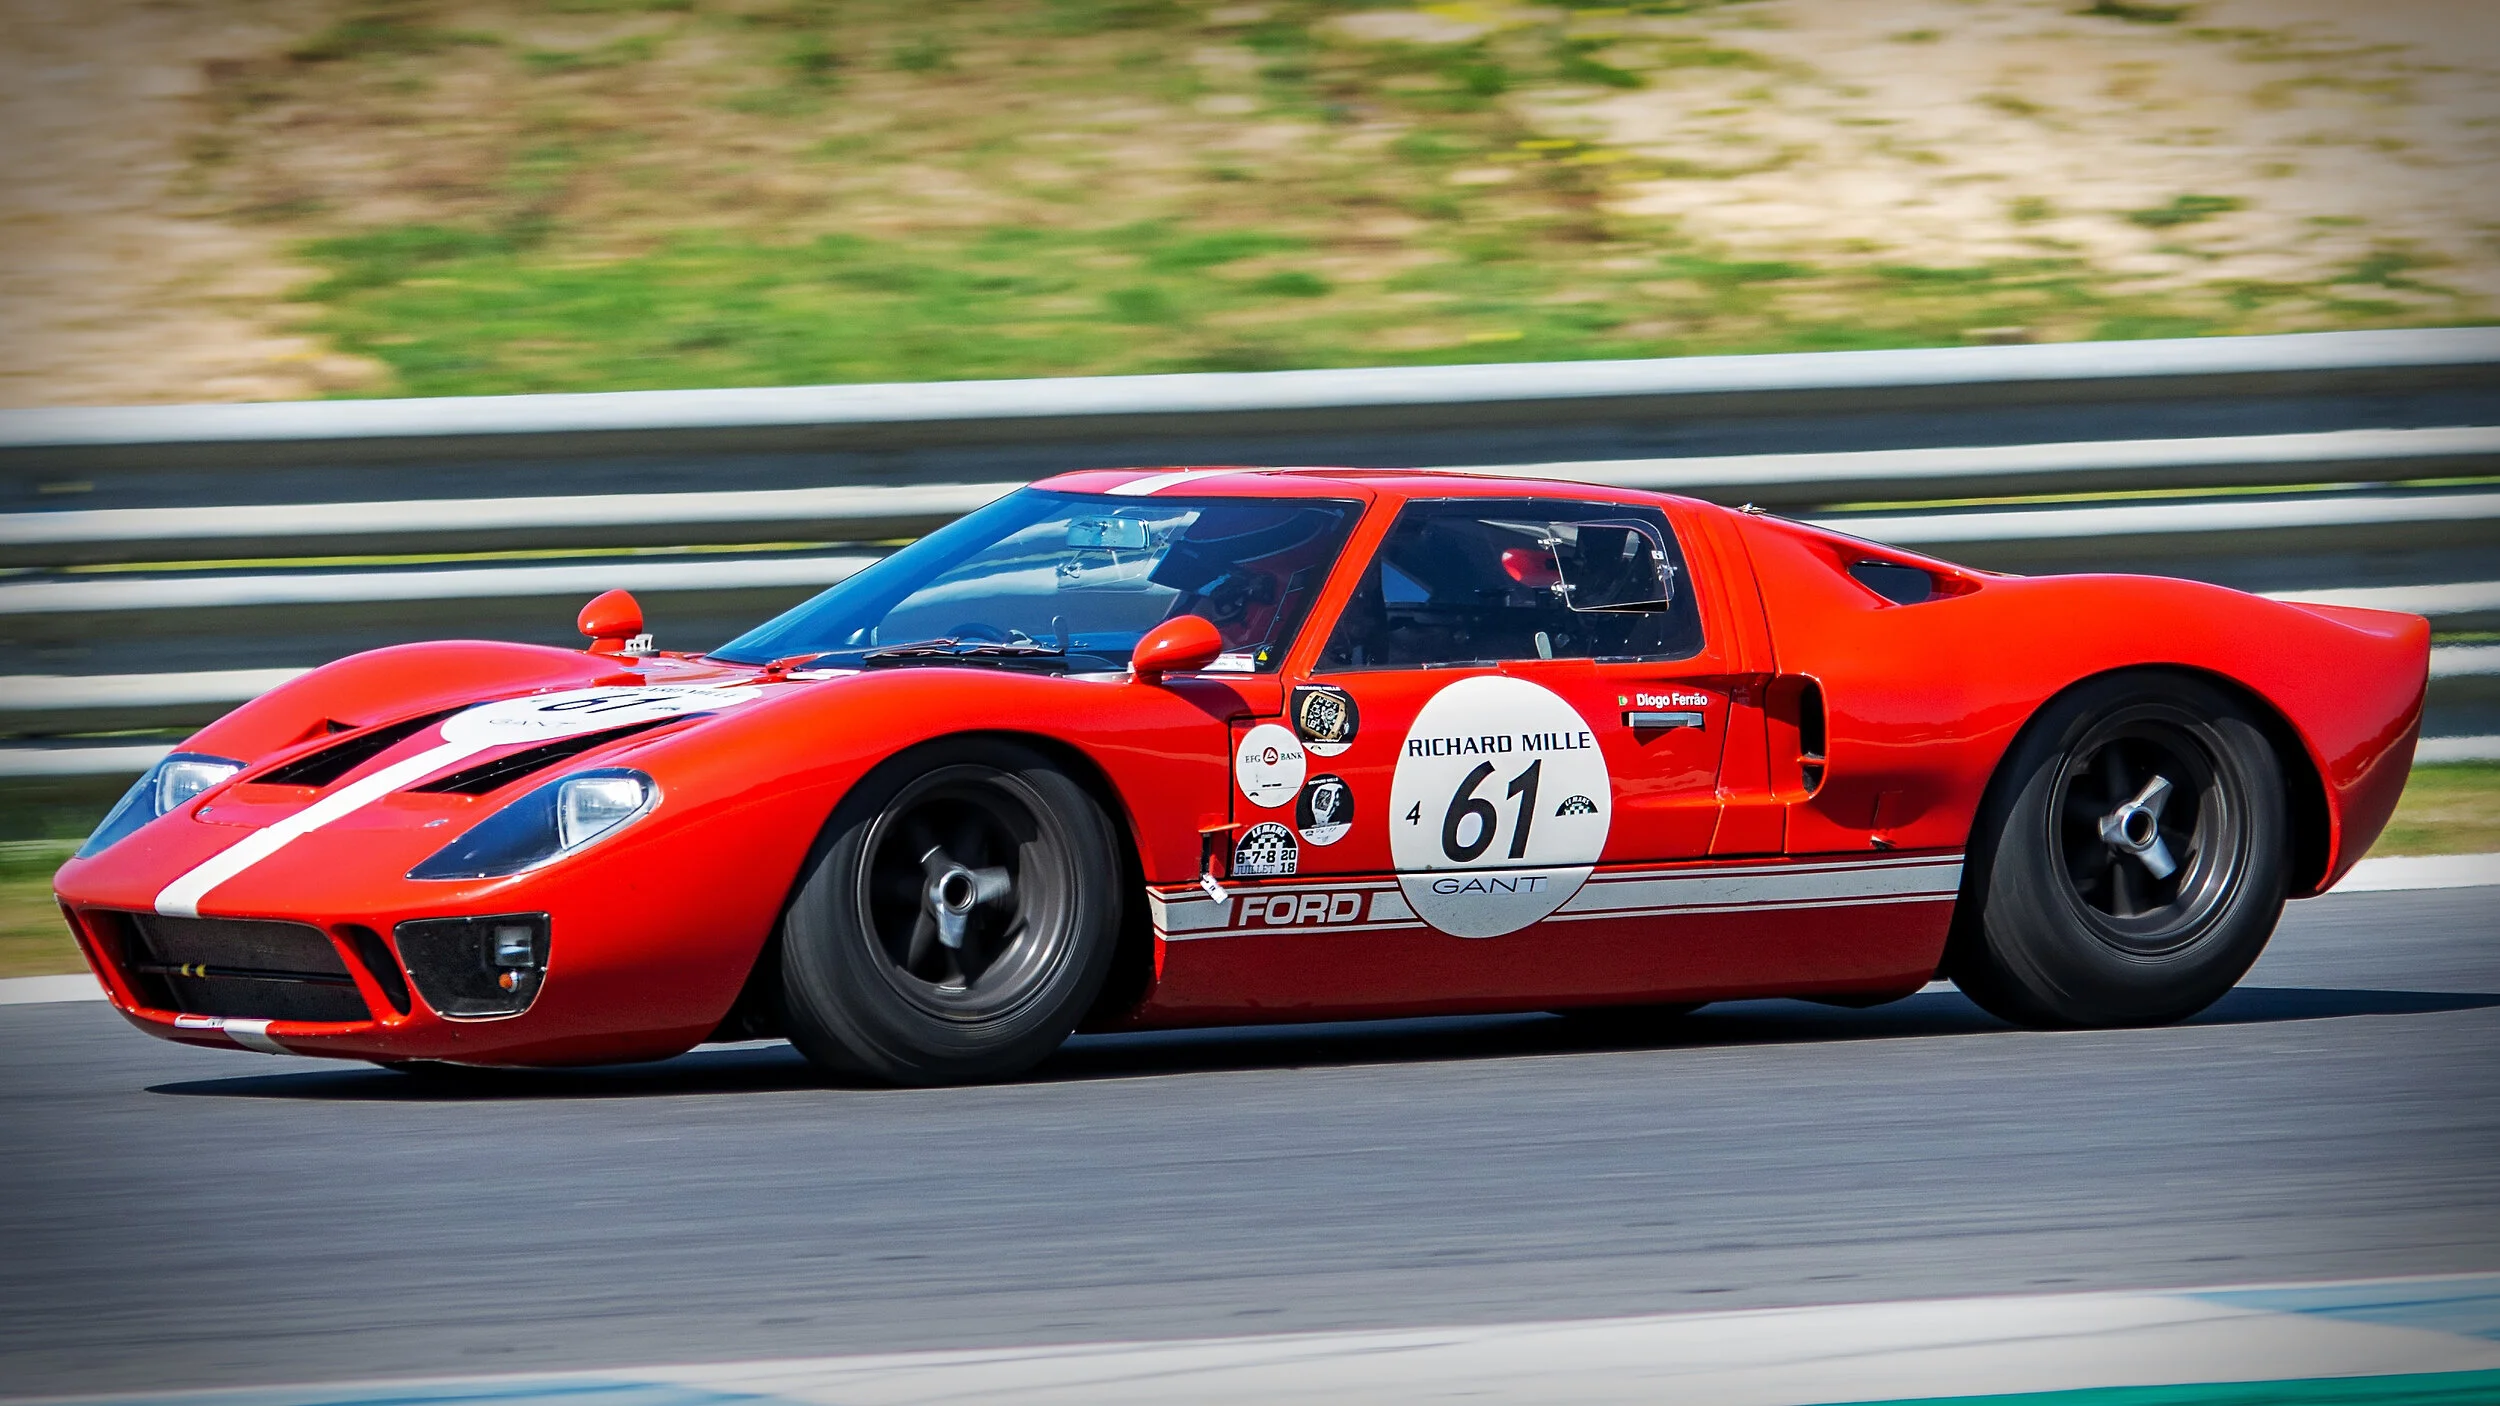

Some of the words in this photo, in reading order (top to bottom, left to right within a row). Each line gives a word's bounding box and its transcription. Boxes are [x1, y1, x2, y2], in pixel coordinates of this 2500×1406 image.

[538, 693, 682, 714] 61
[1636, 693, 1670, 709] Diogo
[1672, 692, 1708, 706] Ferrão
[1408, 735, 1512, 757] RICHARD
[1522, 731, 1591, 752] MILLE
[1245, 755, 1261, 763] EFG
[1280, 752, 1303, 761] BANK
[1405, 800, 1421, 826] 4
[1441, 758, 1542, 863] 61
[1235, 849, 1277, 865] 6-7-8
[1280, 849, 1297, 861] 20
[1234, 865, 1275, 875] JUILLET
[1279, 862, 1296, 874] 18
[1432, 876, 1548, 895] GANT
[1238, 893, 1362, 926] FORD
